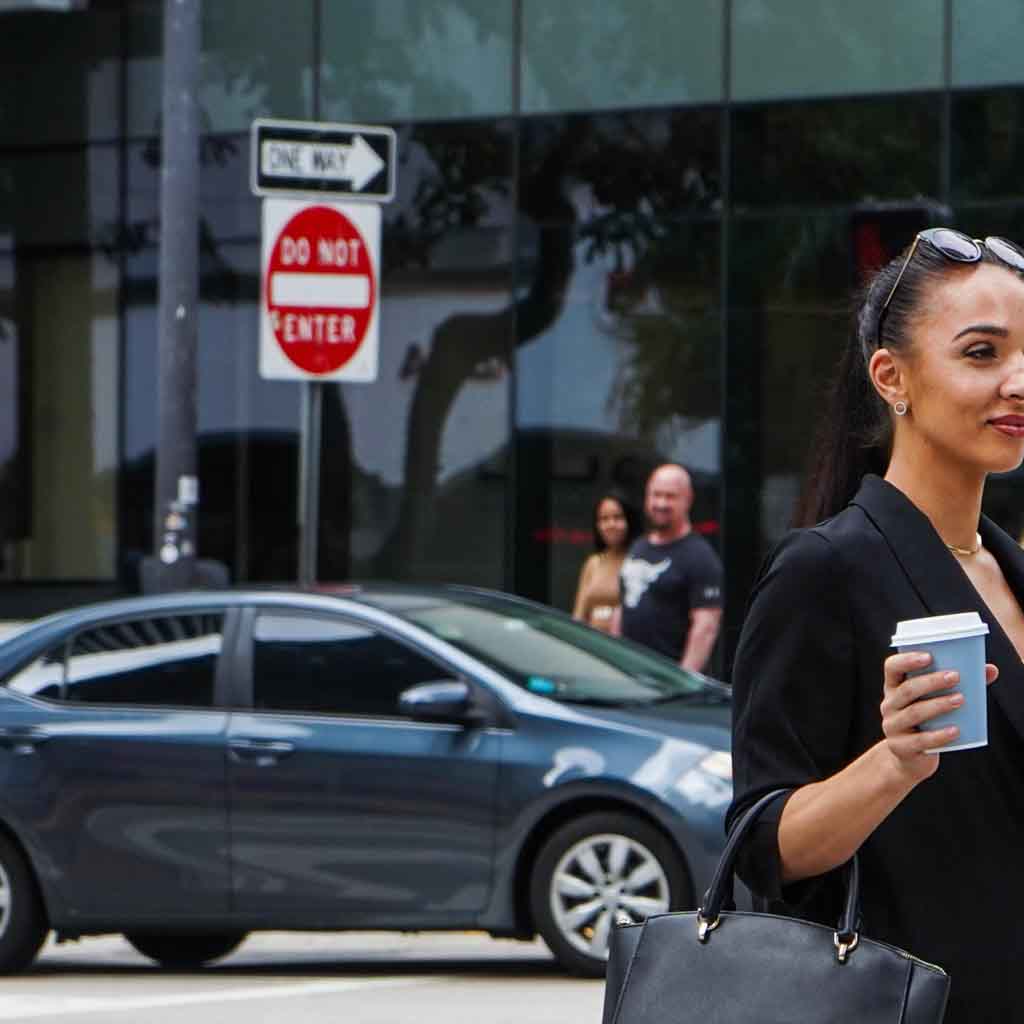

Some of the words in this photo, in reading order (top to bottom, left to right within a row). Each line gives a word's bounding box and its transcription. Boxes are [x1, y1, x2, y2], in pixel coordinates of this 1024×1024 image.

[269, 145, 303, 171] ONE
[312, 148, 350, 172] WAY
[279, 236, 311, 266] DO
[317, 238, 361, 267] NOT
[282, 313, 357, 344] ENTER
